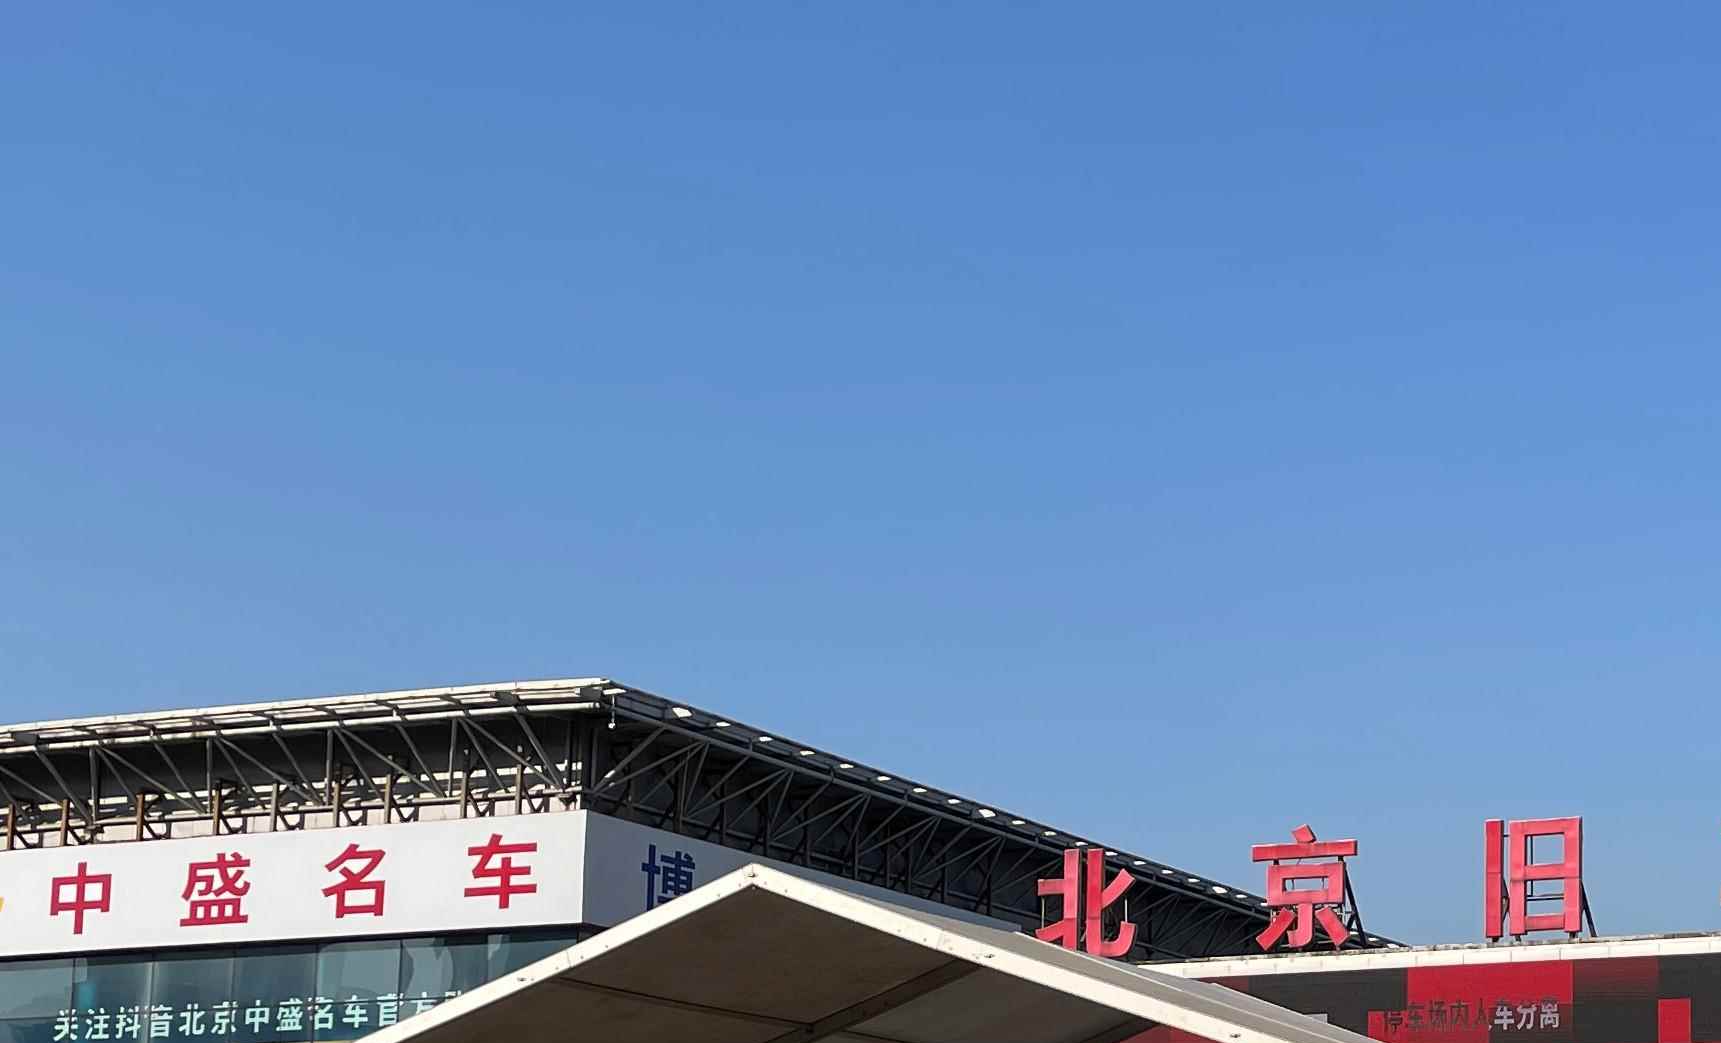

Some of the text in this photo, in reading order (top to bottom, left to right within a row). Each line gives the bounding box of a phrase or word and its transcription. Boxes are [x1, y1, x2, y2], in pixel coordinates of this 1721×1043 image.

[50, 833, 538, 934] 中盛名车
[52, 991, 464, 1041] 关注抖音北京中盛名车官方
